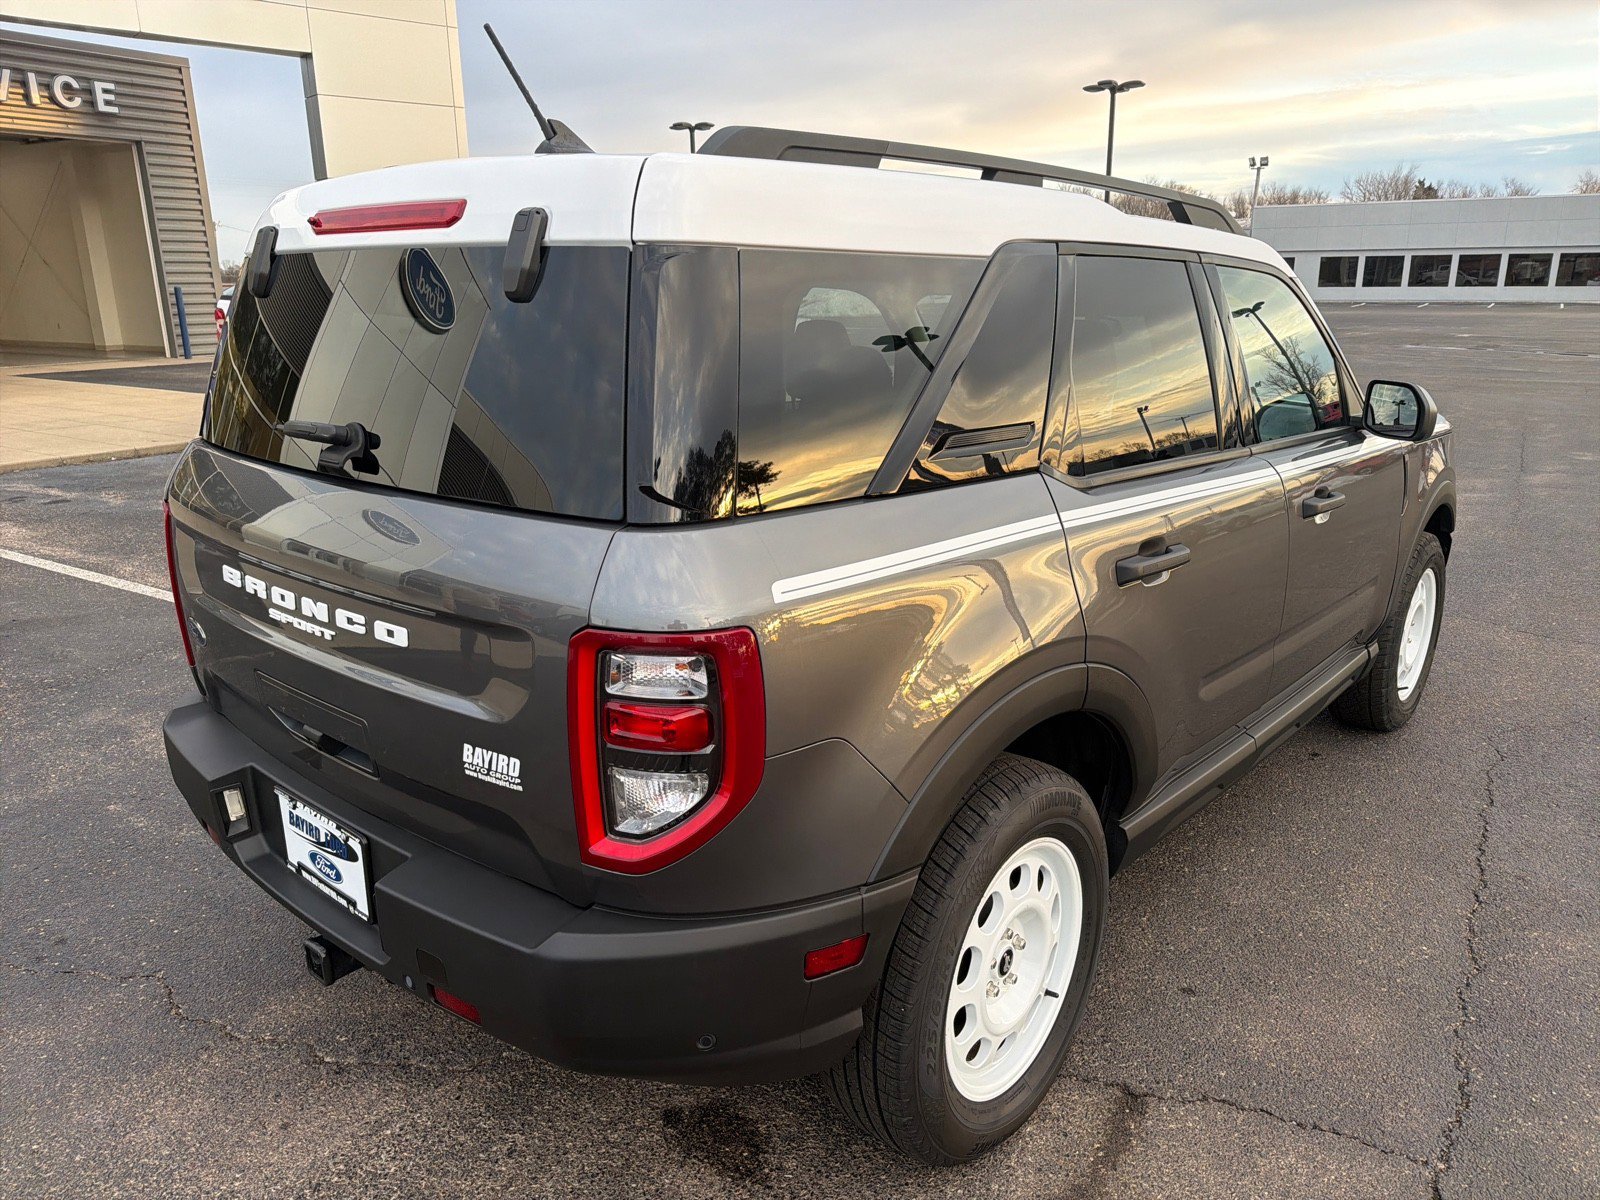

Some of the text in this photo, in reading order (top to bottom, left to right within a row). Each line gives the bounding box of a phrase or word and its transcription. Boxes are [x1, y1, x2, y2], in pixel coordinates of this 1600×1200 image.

[222, 564, 409, 647] BRONCO
[268, 608, 336, 640] SPORT
[463, 743, 520, 777] BAYIRD
[463, 762, 521, 784] AUTO GROUP
[288, 809, 349, 860] BAYIRD FORD
[315, 855, 337, 880] Ford
